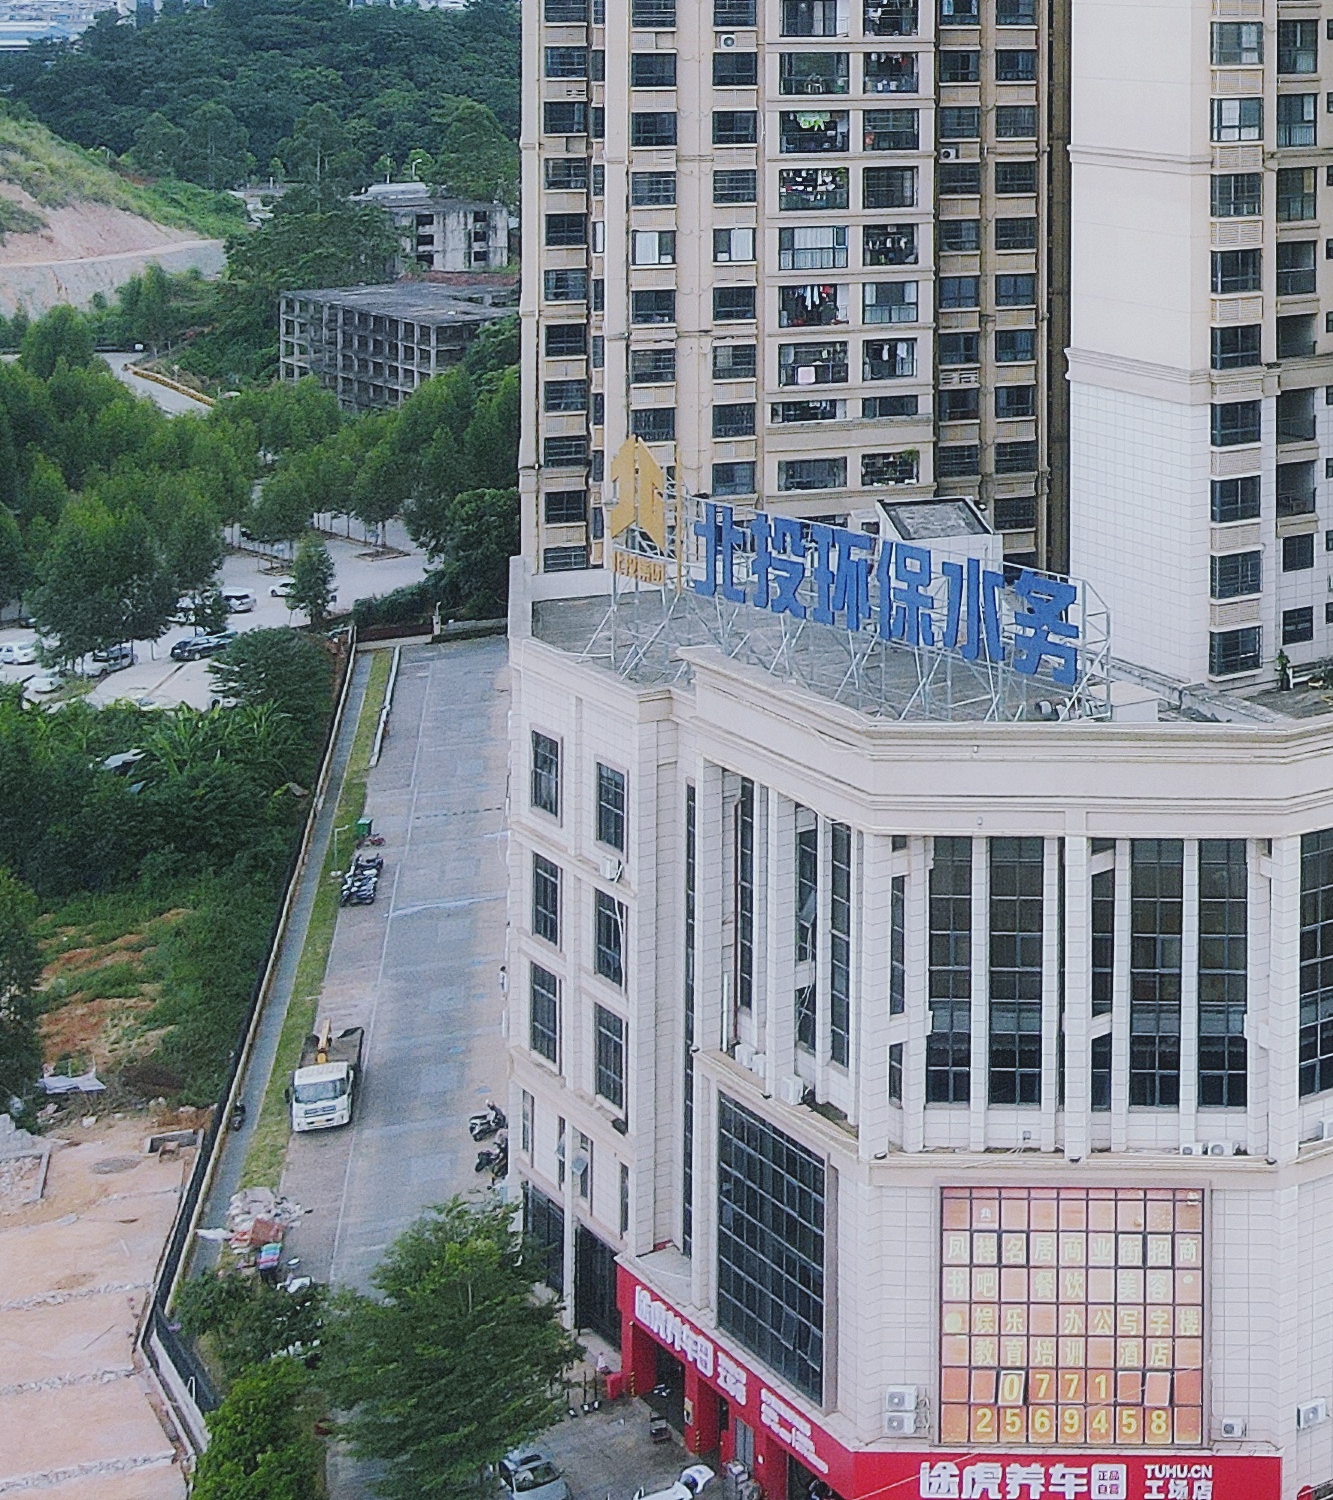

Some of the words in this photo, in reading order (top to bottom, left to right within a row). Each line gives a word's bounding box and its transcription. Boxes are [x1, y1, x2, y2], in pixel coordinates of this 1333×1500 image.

[694, 502, 1079, 685] 北投环保水务
[947, 1237, 1198, 1264] 凤祥名居商业街招商
[947, 1271, 995, 1298] 书吧
[1034, 1272, 1085, 1299] 餐饮
[1118, 1273, 1167, 1299] 美容
[973, 1308, 1024, 1333] 娱乐
[1063, 1308, 1199, 1336] 办公写字楼
[975, 1340, 1084, 1367] 教育培训
[1120, 1341, 1171, 1367] 酒店
[1003, 1373, 1107, 1401] 0771
[975, 1409, 1168, 1434] 2569458
[920, 1461, 1089, 1499] 途虎养车
[1144, 1464, 1213, 1479] TUHU.CN
[1143, 1479, 1213, 1500] 工场店
